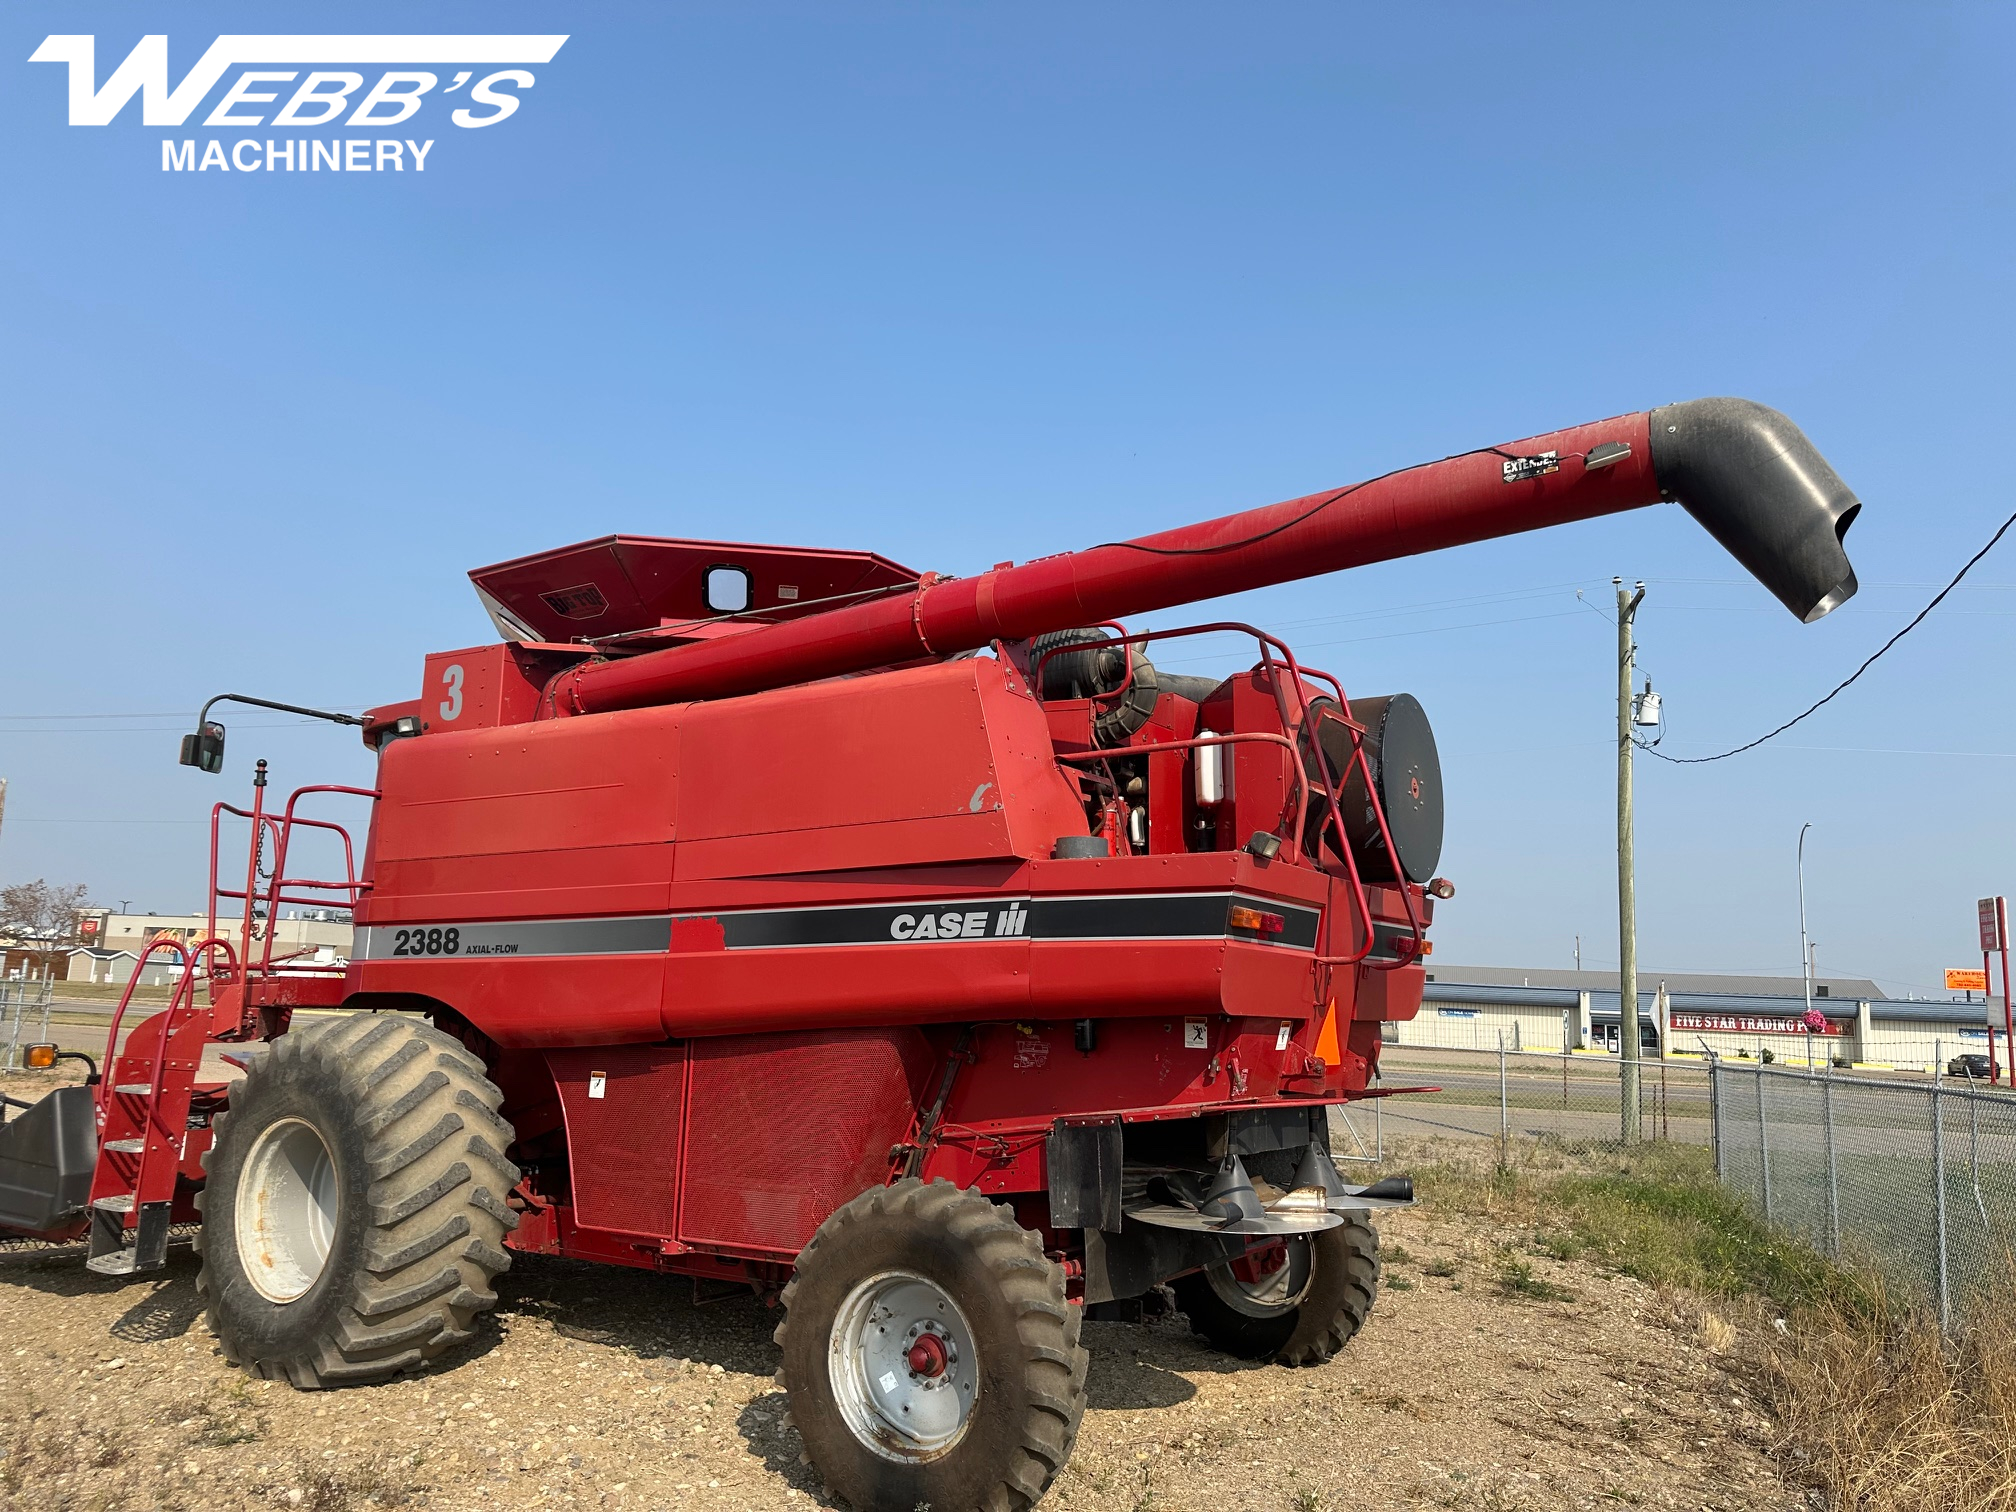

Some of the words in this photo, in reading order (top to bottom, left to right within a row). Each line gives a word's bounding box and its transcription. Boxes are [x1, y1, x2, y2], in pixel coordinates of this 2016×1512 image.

[440, 664, 464, 721] 3
[890, 911, 989, 940] CASE
[393, 928, 460, 956] 2388
[1676, 1015, 1702, 1027] FIVE
[1704, 1016, 1737, 1029] STAR
[1739, 1017, 1795, 1032] TRADING
